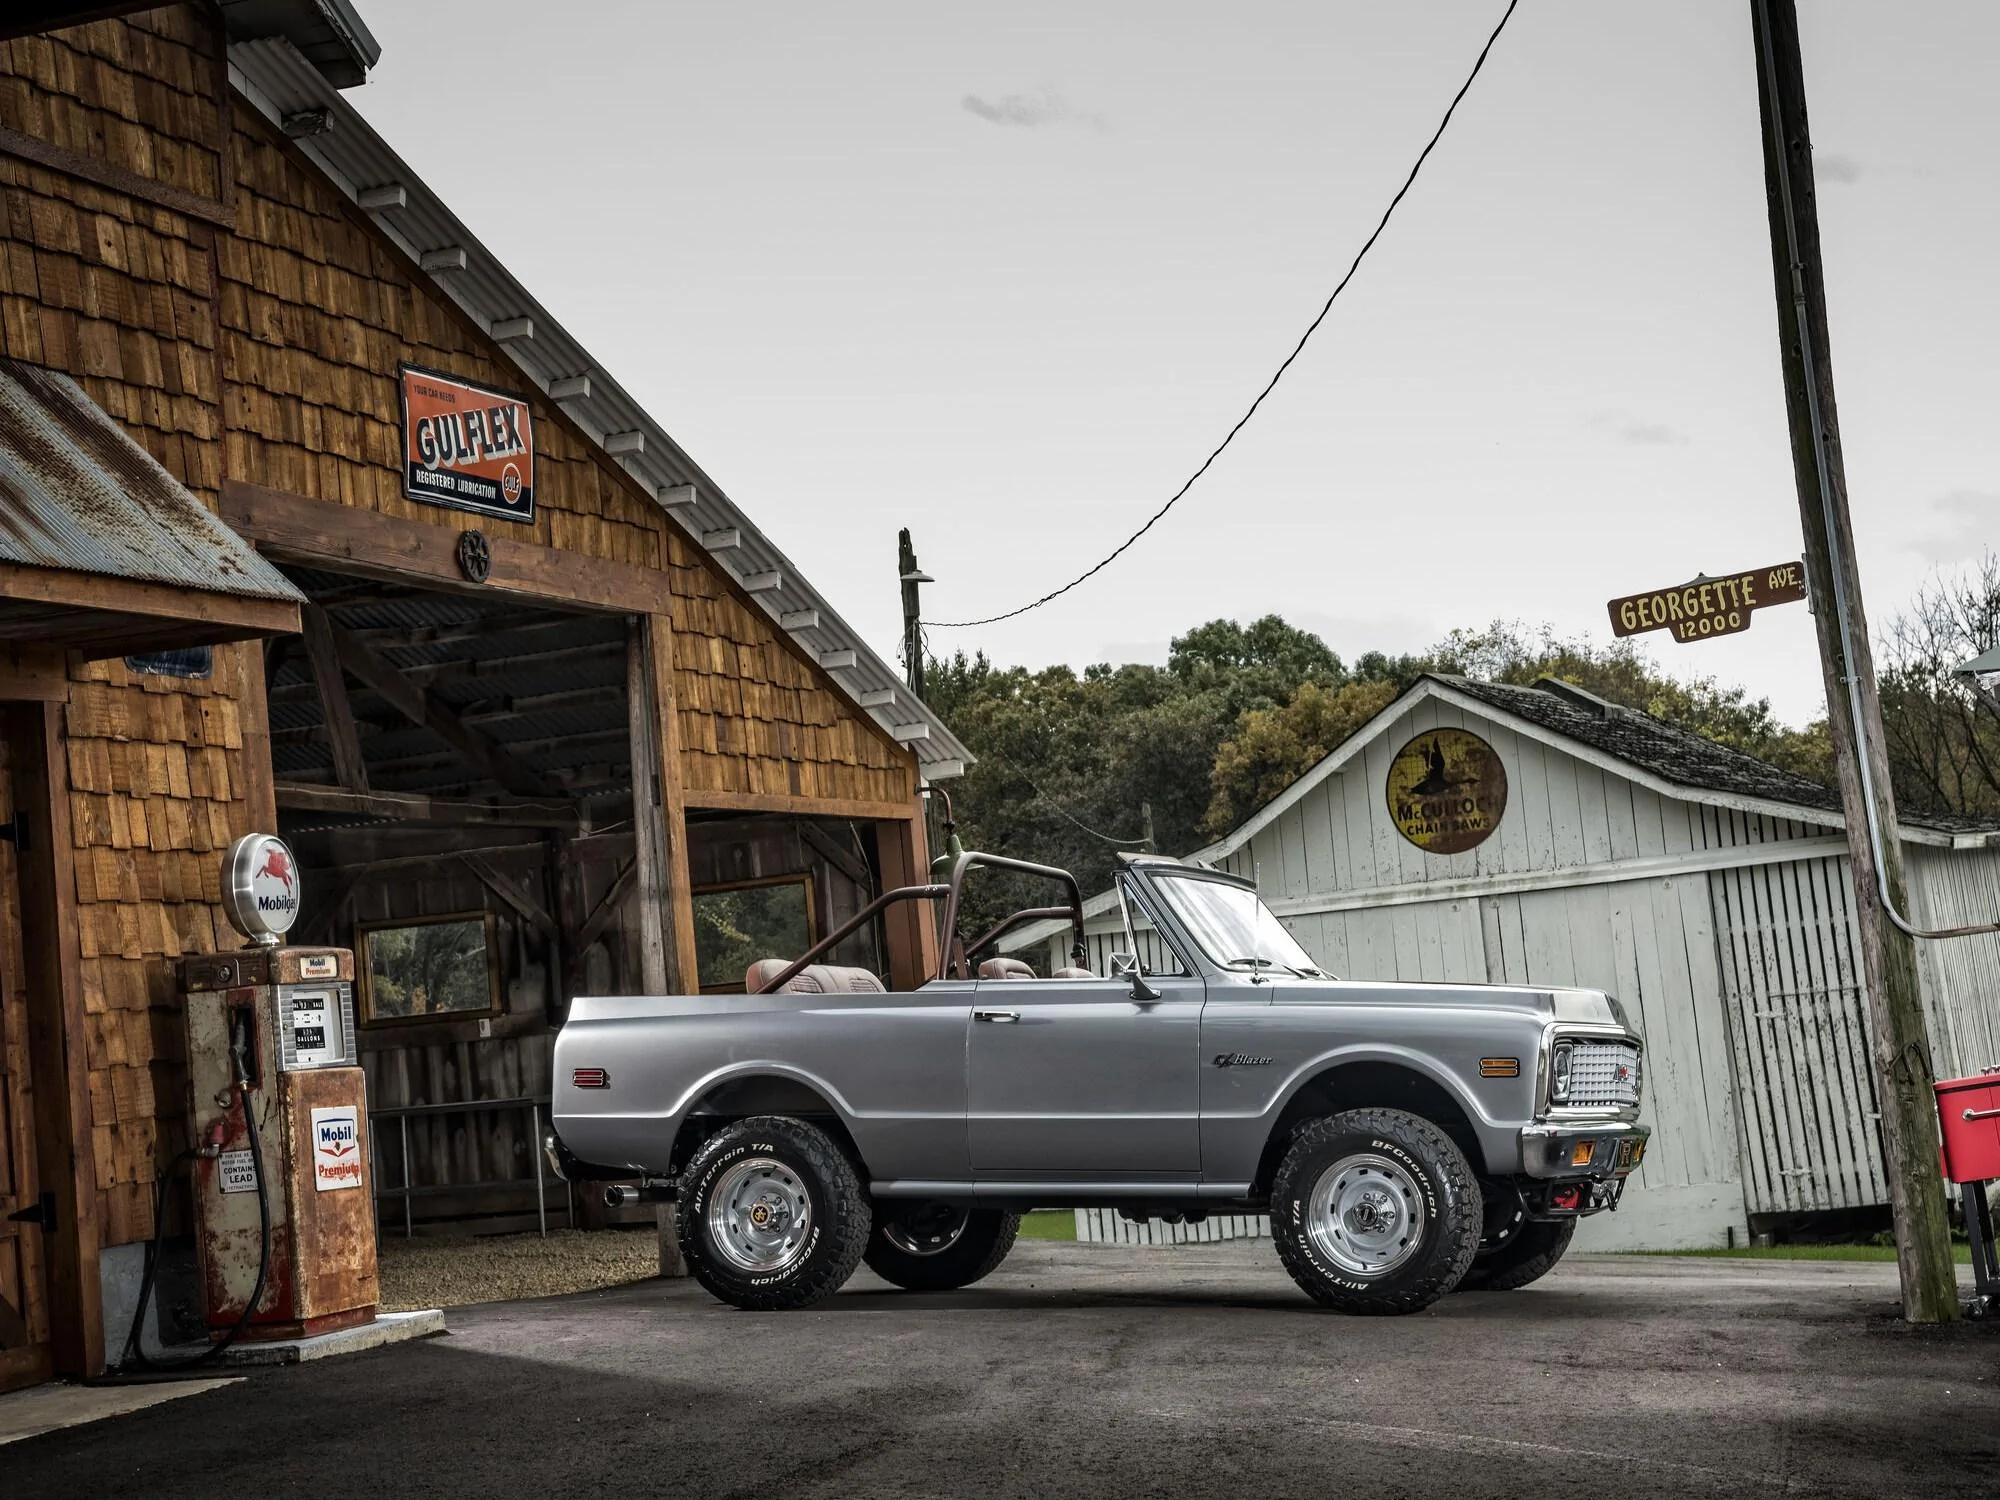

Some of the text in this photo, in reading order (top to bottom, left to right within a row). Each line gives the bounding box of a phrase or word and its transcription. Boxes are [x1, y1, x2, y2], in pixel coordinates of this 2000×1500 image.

[413, 384, 455, 404] YOUR CAR NEEDS
[416, 403, 527, 470] GULFLEX
[416, 469, 496, 499] REGISTERED LUBRICATION
[505, 475, 520, 493] GULF
[1620, 576, 1757, 630] GEORGETTE
[1679, 612, 1741, 639] 12000
[258, 896, 296, 914] Mobilgas
[305, 967, 331, 975] Premium
[309, 959, 326, 967] Mobil
[1234, 1053, 1272, 1065] Blazer
[321, 1126, 352, 1142] Mobil
[229, 1174, 253, 1183] LEAD
[694, 1143, 774, 1214] All-Terrain T/A
[1371, 1140, 1438, 1218] BFGoodrich
[751, 1225, 820, 1286] BFGoodrich
[1292, 1200, 1369, 1290] All-Terrain T/A
